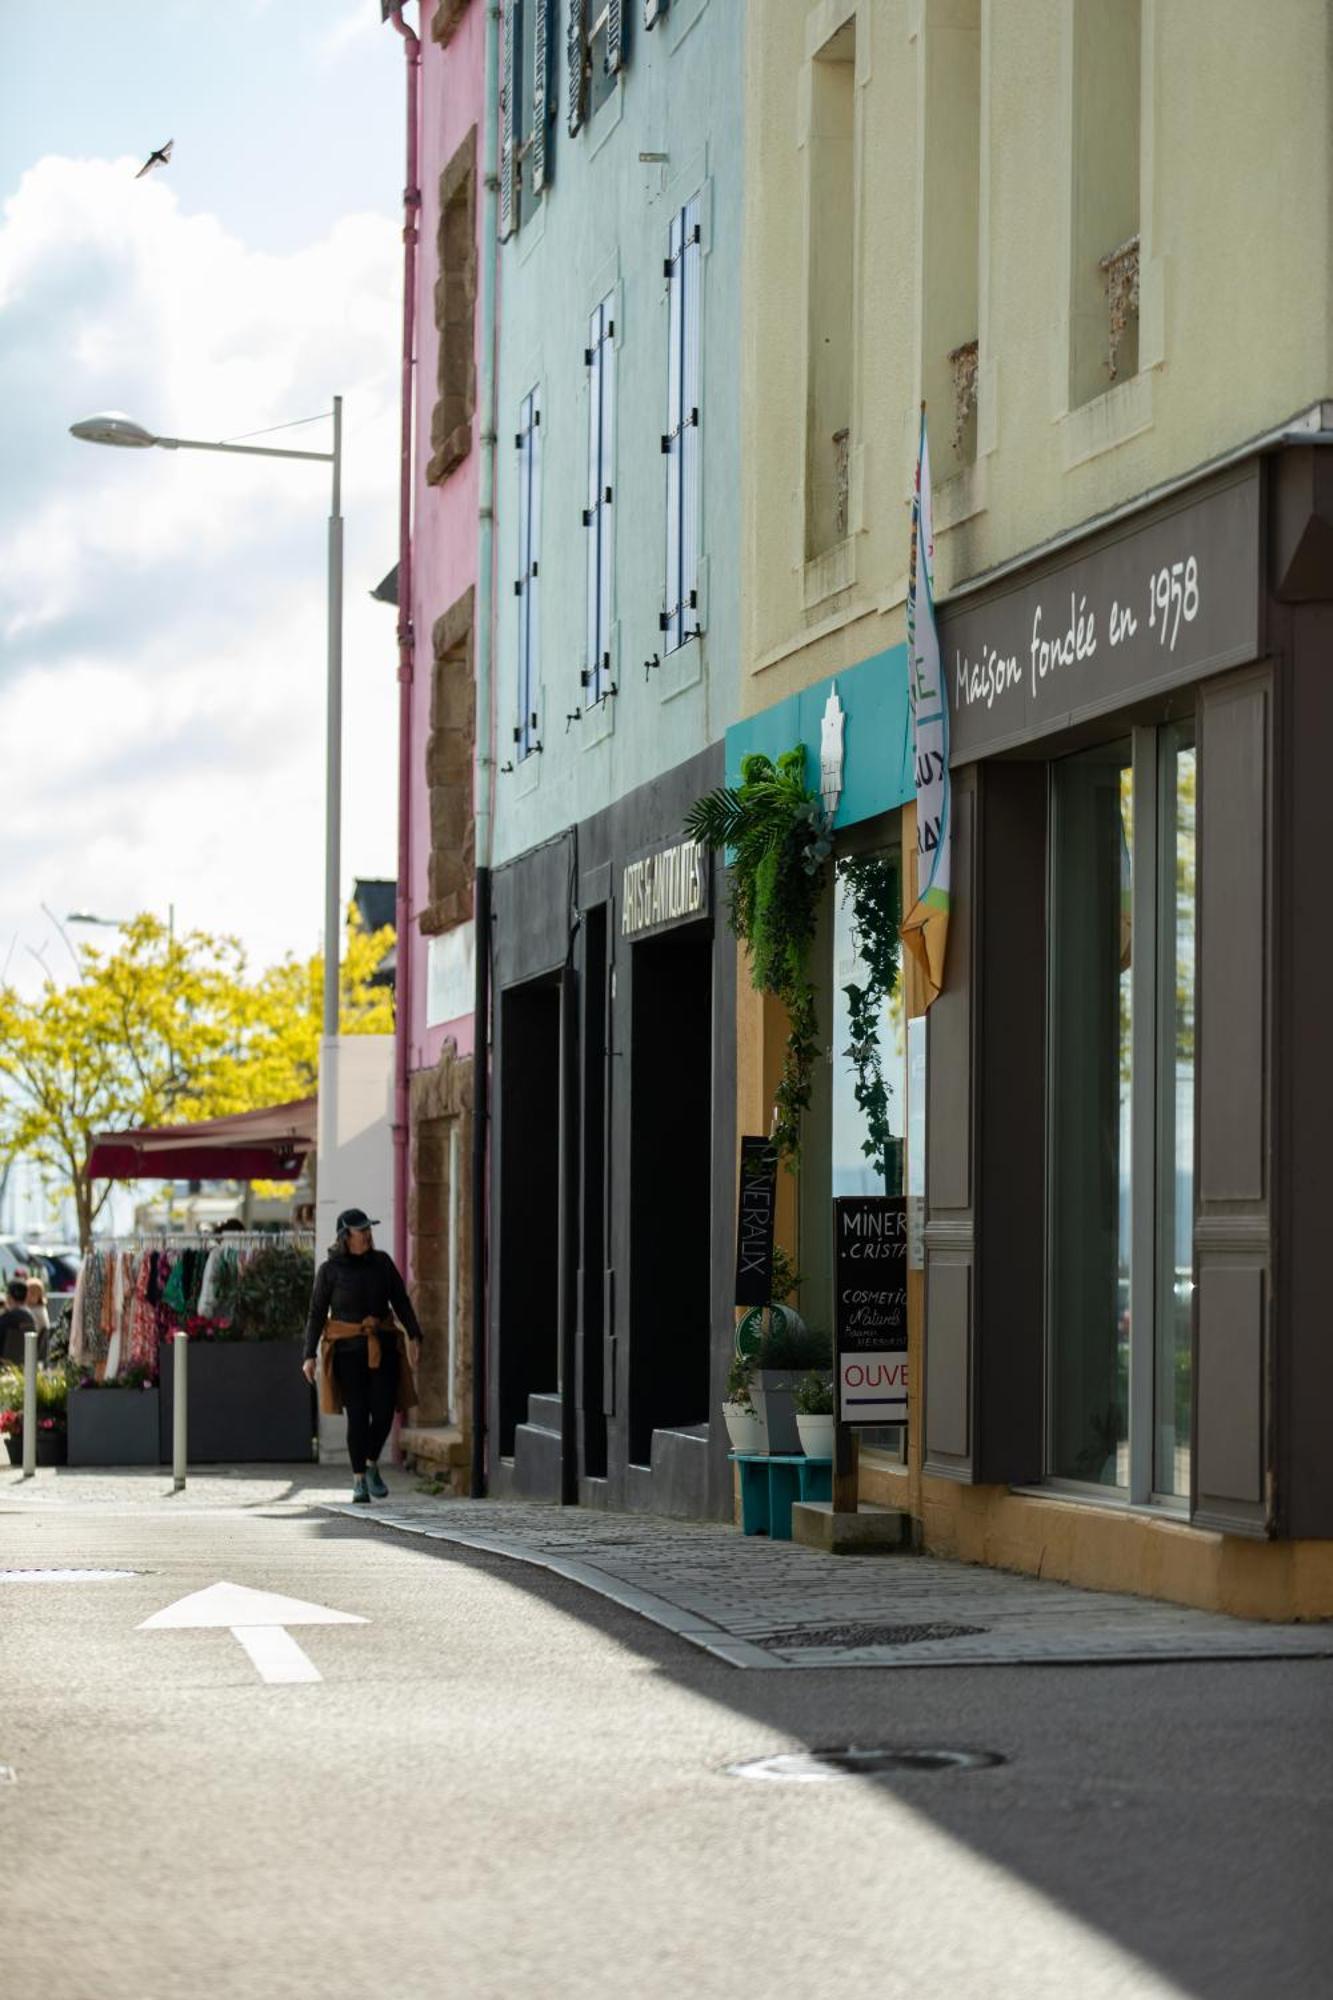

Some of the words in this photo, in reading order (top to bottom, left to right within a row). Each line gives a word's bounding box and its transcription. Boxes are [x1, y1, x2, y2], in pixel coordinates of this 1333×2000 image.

[955, 645, 1021, 711] Maison
[1030, 592, 1097, 698] fondée
[1108, 600, 1137, 647] en
[1149, 555, 1200, 651] 1958
[621, 860, 644, 936] ARTS
[844, 1364, 909, 1387] OUVE
